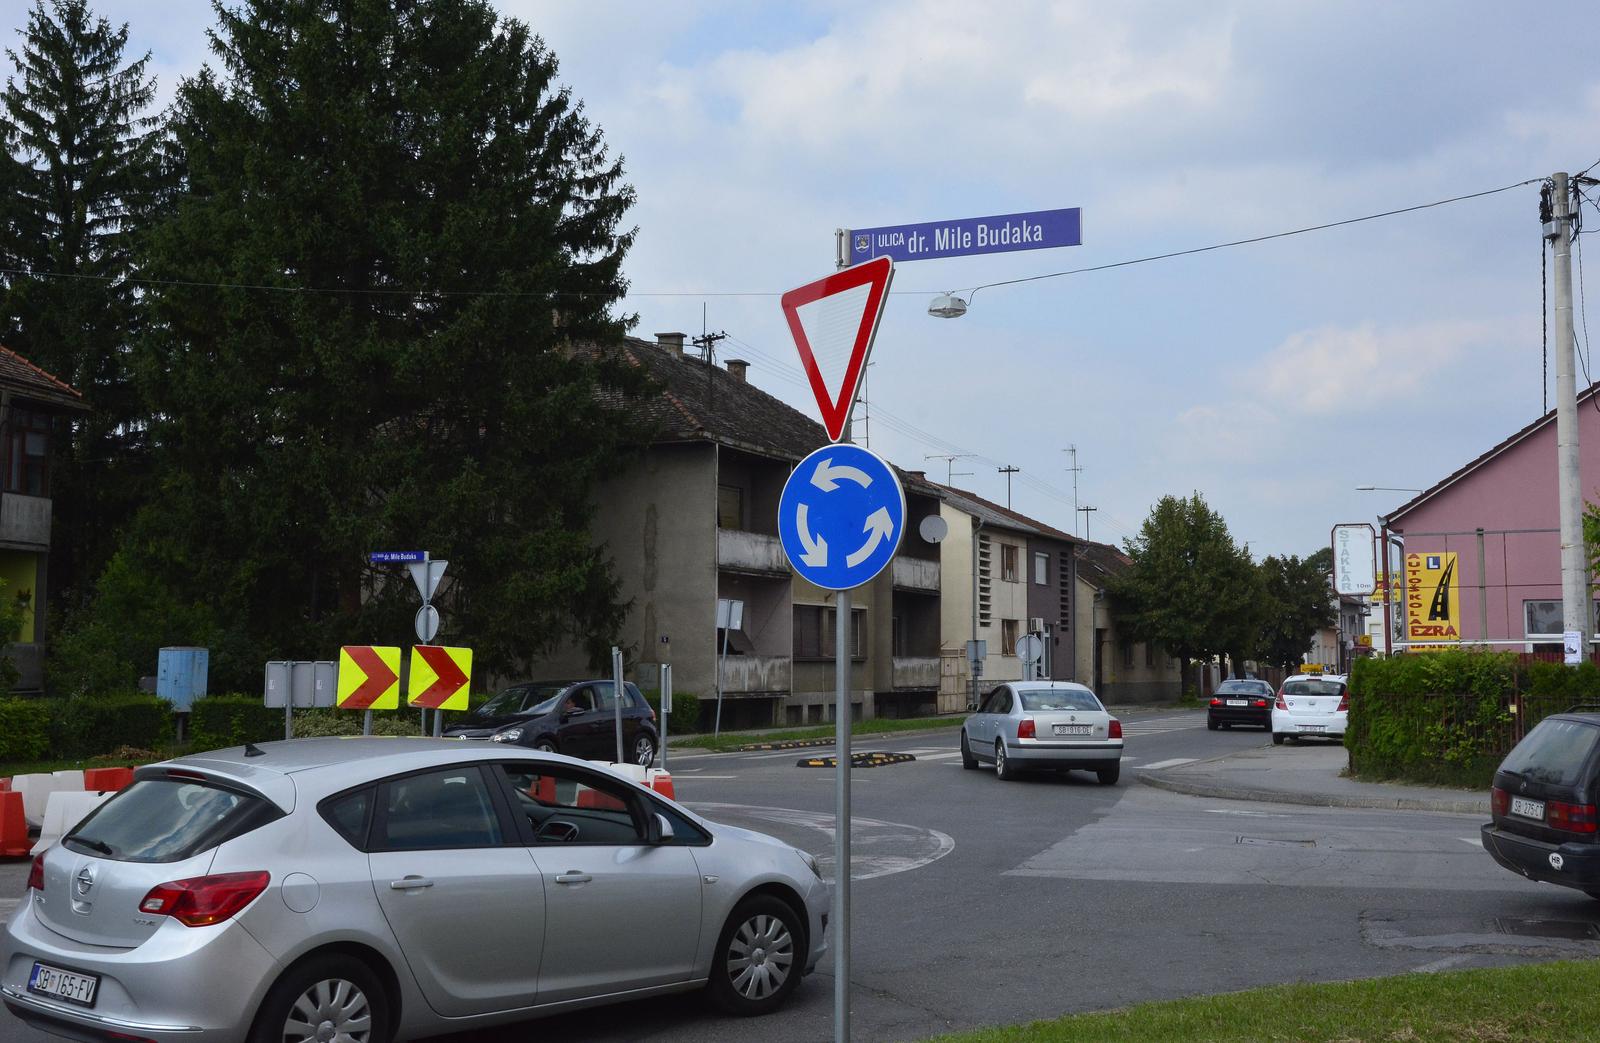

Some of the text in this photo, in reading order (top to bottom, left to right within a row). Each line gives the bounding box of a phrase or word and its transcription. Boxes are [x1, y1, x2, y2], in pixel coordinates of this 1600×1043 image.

[878, 220, 1043, 254] ULICA dr. Mile Budaka
[1339, 530, 1351, 590] STAKLAR
[1429, 557, 1439, 568] L
[1411, 625, 1457, 636] EZRA
[36, 969, 51, 989] SB
